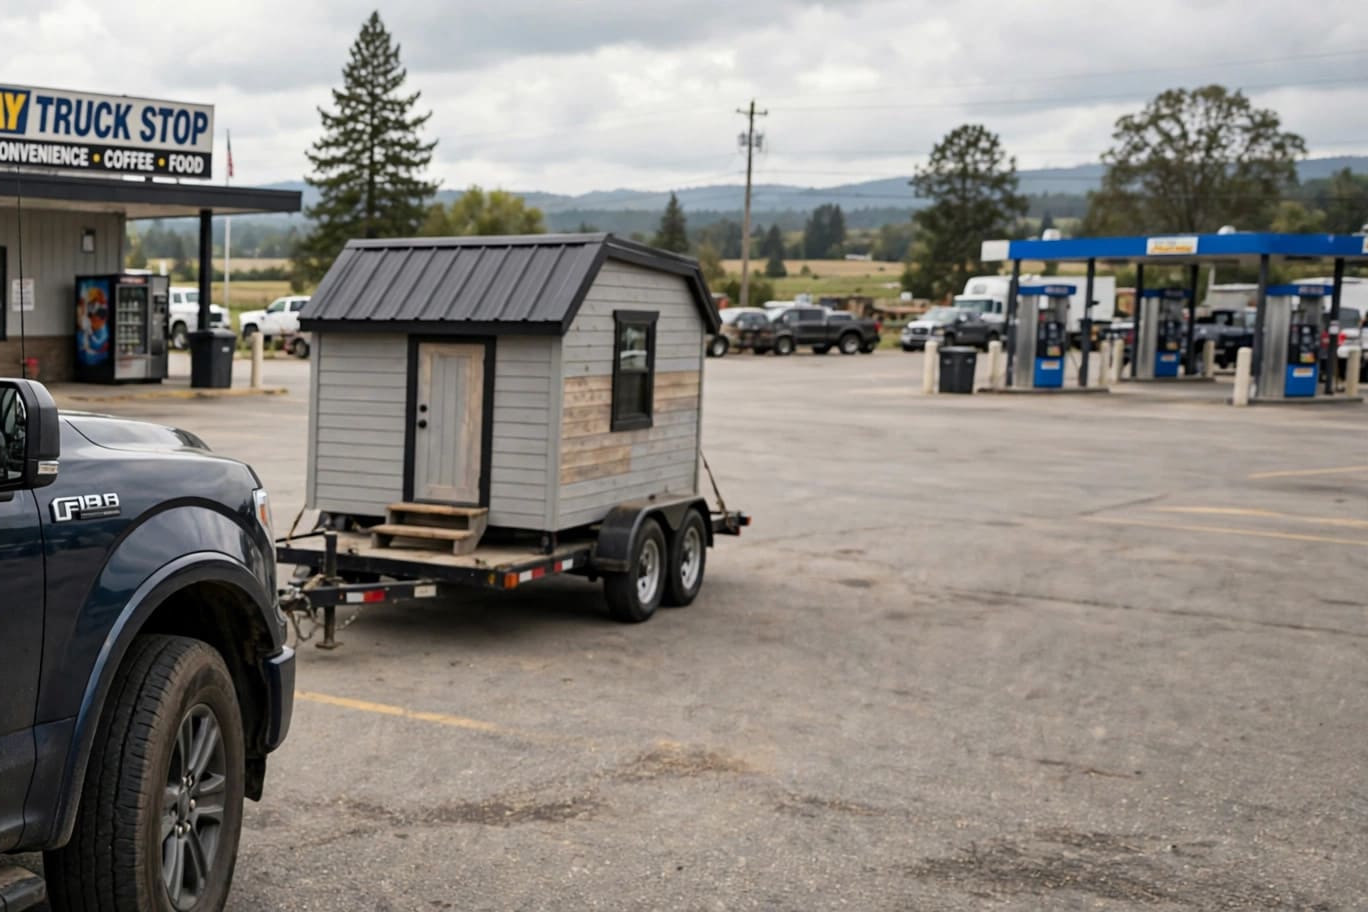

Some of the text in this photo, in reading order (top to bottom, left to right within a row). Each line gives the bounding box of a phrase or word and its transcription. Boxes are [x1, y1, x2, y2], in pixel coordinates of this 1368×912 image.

[36, 96, 131, 140] TRUCK
[140, 105, 208, 146] STOP
[104, 150, 154, 171] COFFEE
[169, 154, 204, 174] FOOD
